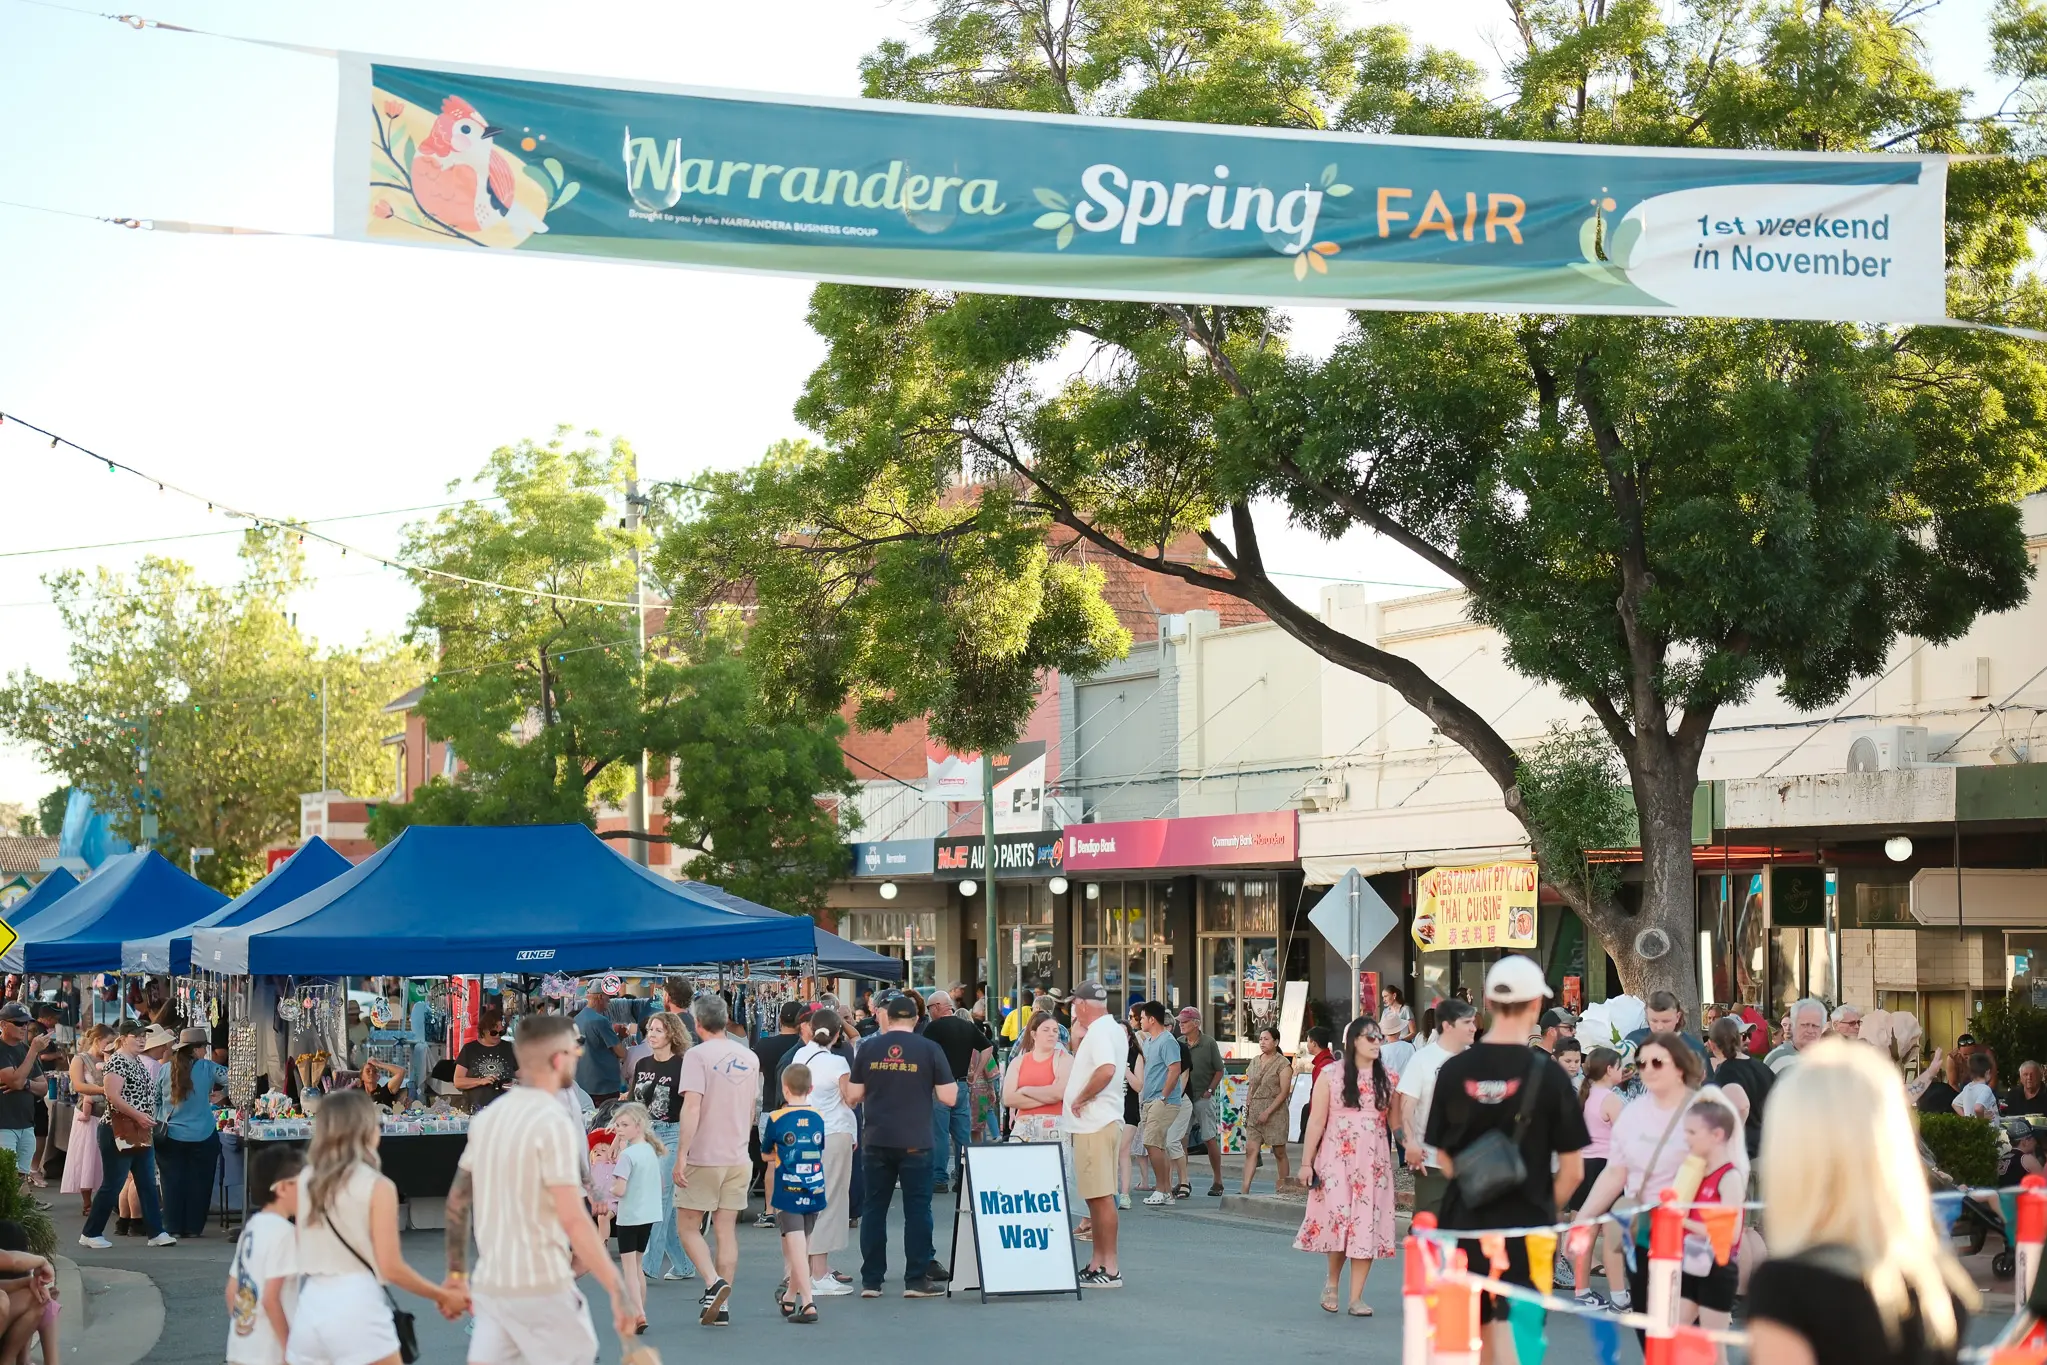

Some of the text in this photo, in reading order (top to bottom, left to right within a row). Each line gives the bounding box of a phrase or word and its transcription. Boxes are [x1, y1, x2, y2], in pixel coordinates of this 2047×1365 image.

[622, 137, 1526, 255] Narrandera Spring FAIR
[628, 208, 879, 237] Brought to you by the NARRANDERA BUSINESS GROUP
[1697, 213, 1889, 241] 1st weekend
[1694, 243, 1891, 278] in November
[1077, 838, 1100, 858] Bendigo
[1100, 837, 1116, 853] Bank
[1212, 835, 1239, 850] Community
[1239, 833, 1253, 846] Bank
[938, 842, 1035, 870] MJC AUO PARTS
[1437, 867, 1493, 896] RESTAURANT
[1514, 866, 1534, 891] LTD
[1440, 896, 1502, 924] THAI CUISINE
[516, 949, 555, 960] KINGS
[1245, 981, 1275, 999] MJC
[796, 1118, 809, 1127] JOE
[980, 1190, 1061, 1215] Market
[998, 1225, 1048, 1250] Way
